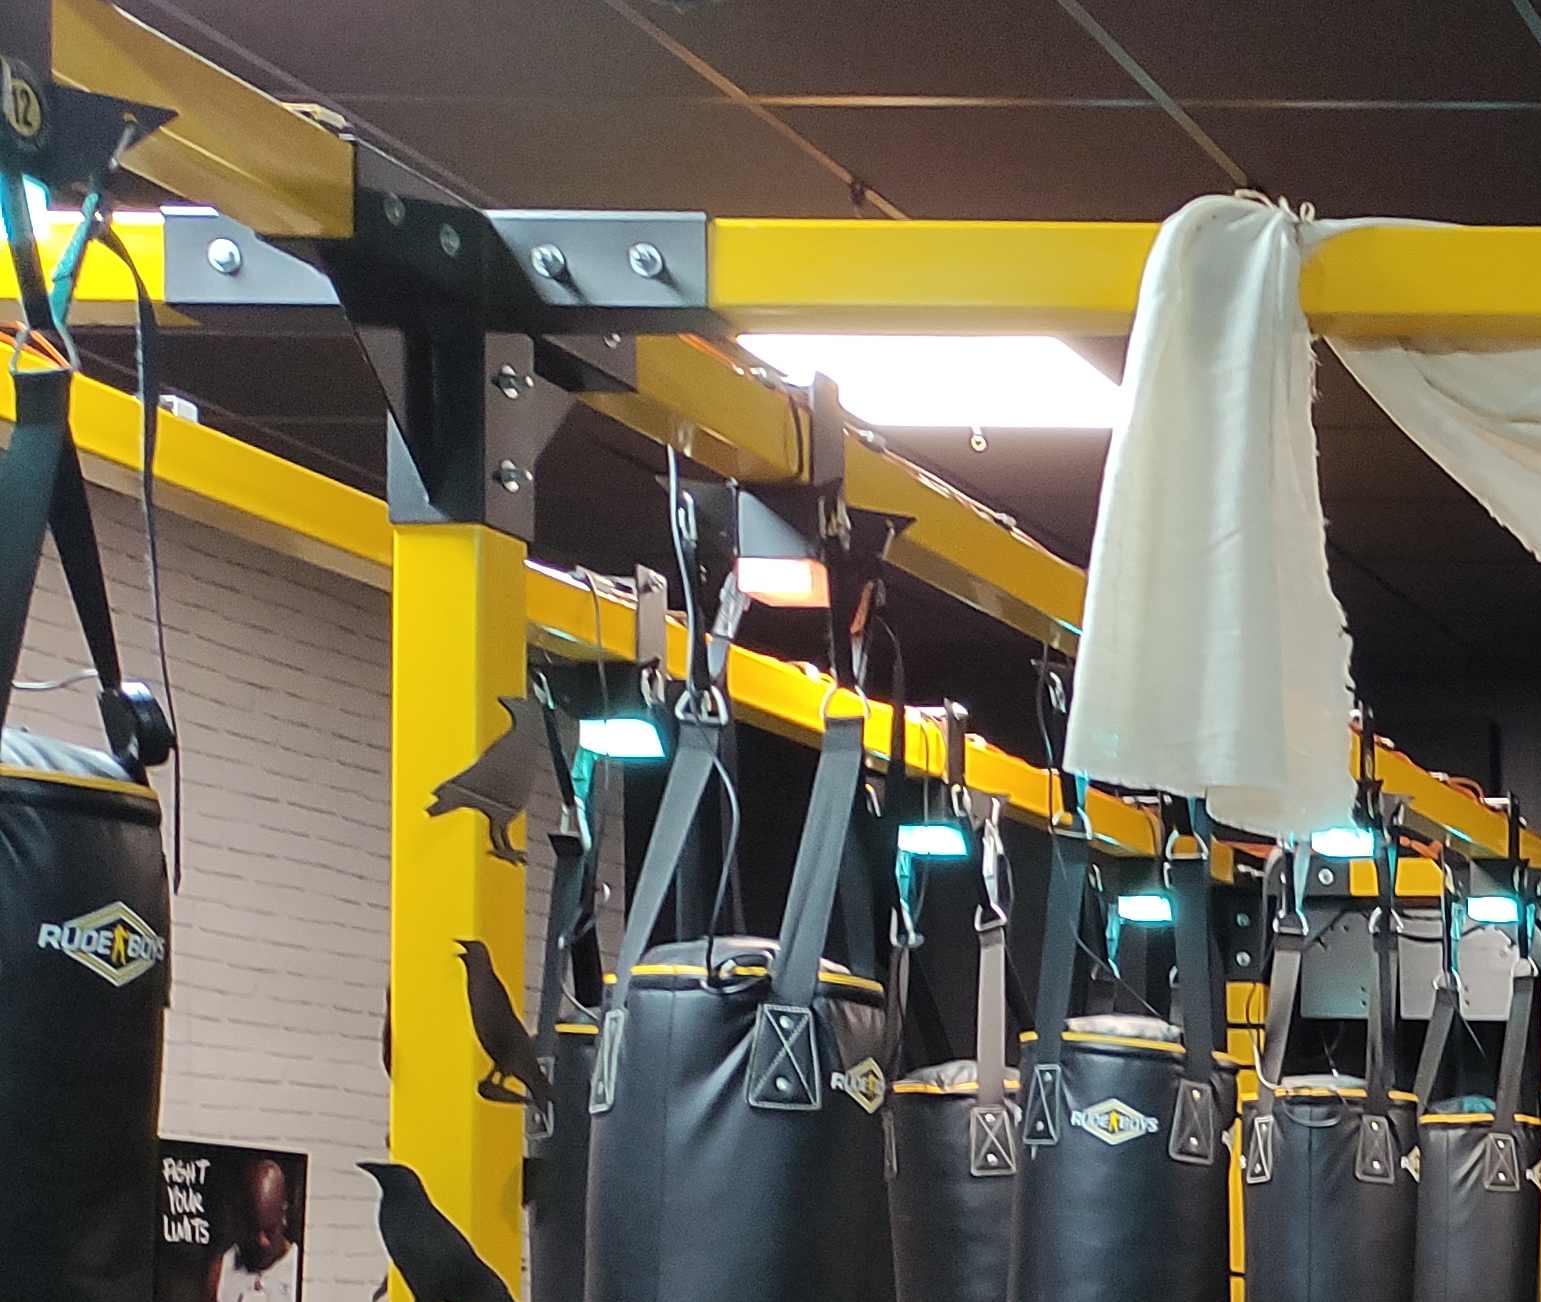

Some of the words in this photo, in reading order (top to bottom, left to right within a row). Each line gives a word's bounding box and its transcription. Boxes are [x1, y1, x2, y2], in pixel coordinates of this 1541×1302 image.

[12, 87, 33, 128] 12
[38, 922, 114, 955] RUDE
[1070, 1110, 1108, 1130] RUDE
[1120, 1116, 1159, 1133] BOYS
[167, 1183, 205, 1216] YOUR
[162, 1213, 210, 1245] LIMITS
